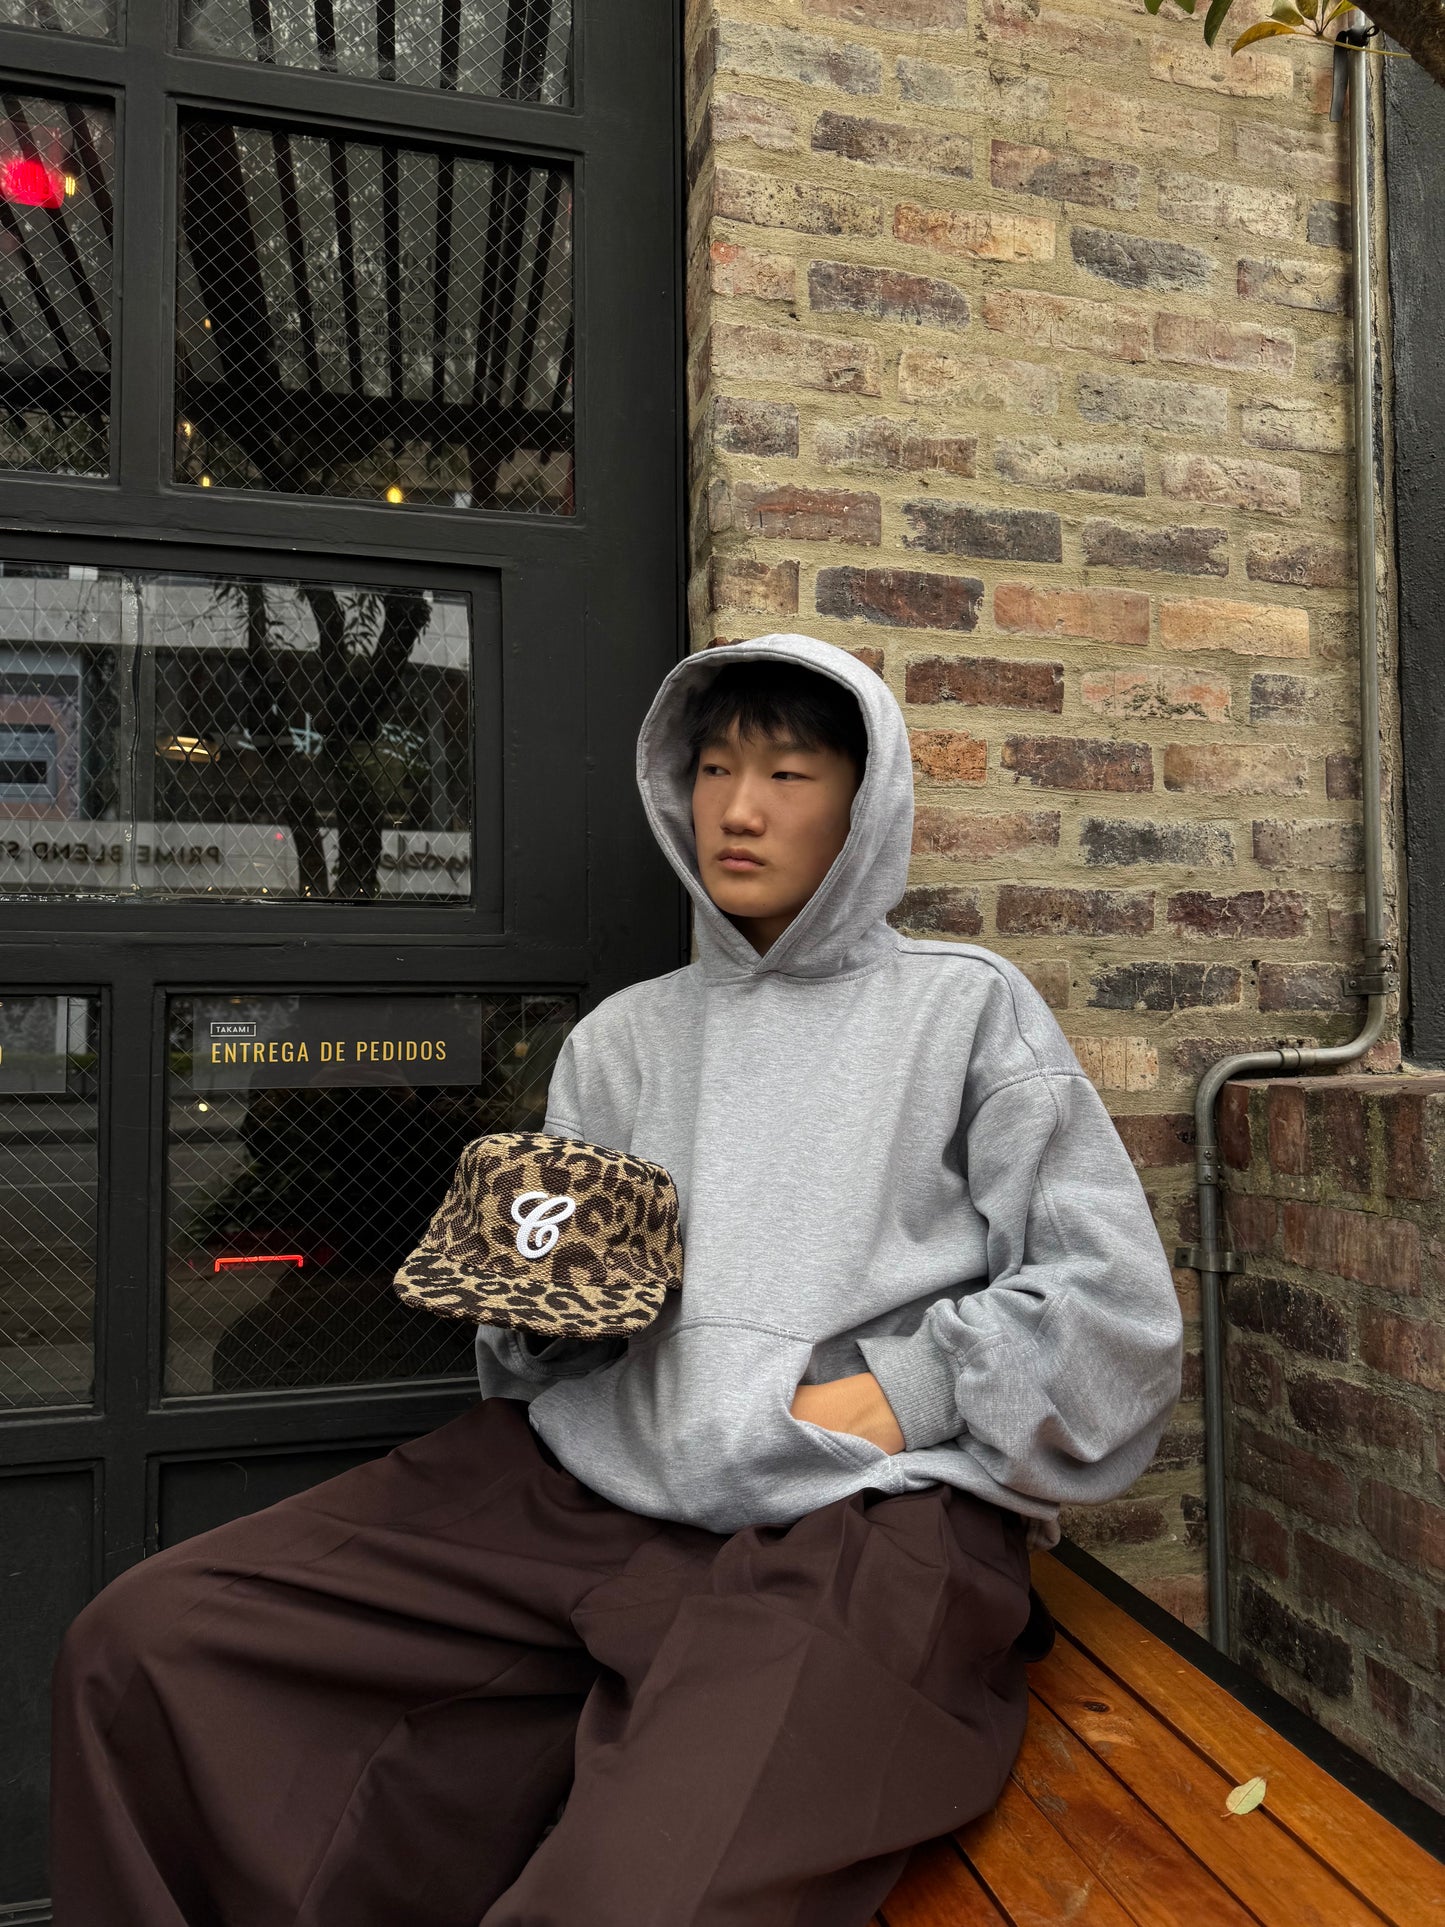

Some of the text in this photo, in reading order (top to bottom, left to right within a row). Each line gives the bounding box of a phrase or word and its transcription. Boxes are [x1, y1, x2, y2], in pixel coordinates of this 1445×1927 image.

[215, 1026, 250, 1034] TAKAMI
[211, 1040, 447, 1063] ENTREGA DE PEDIDOS
